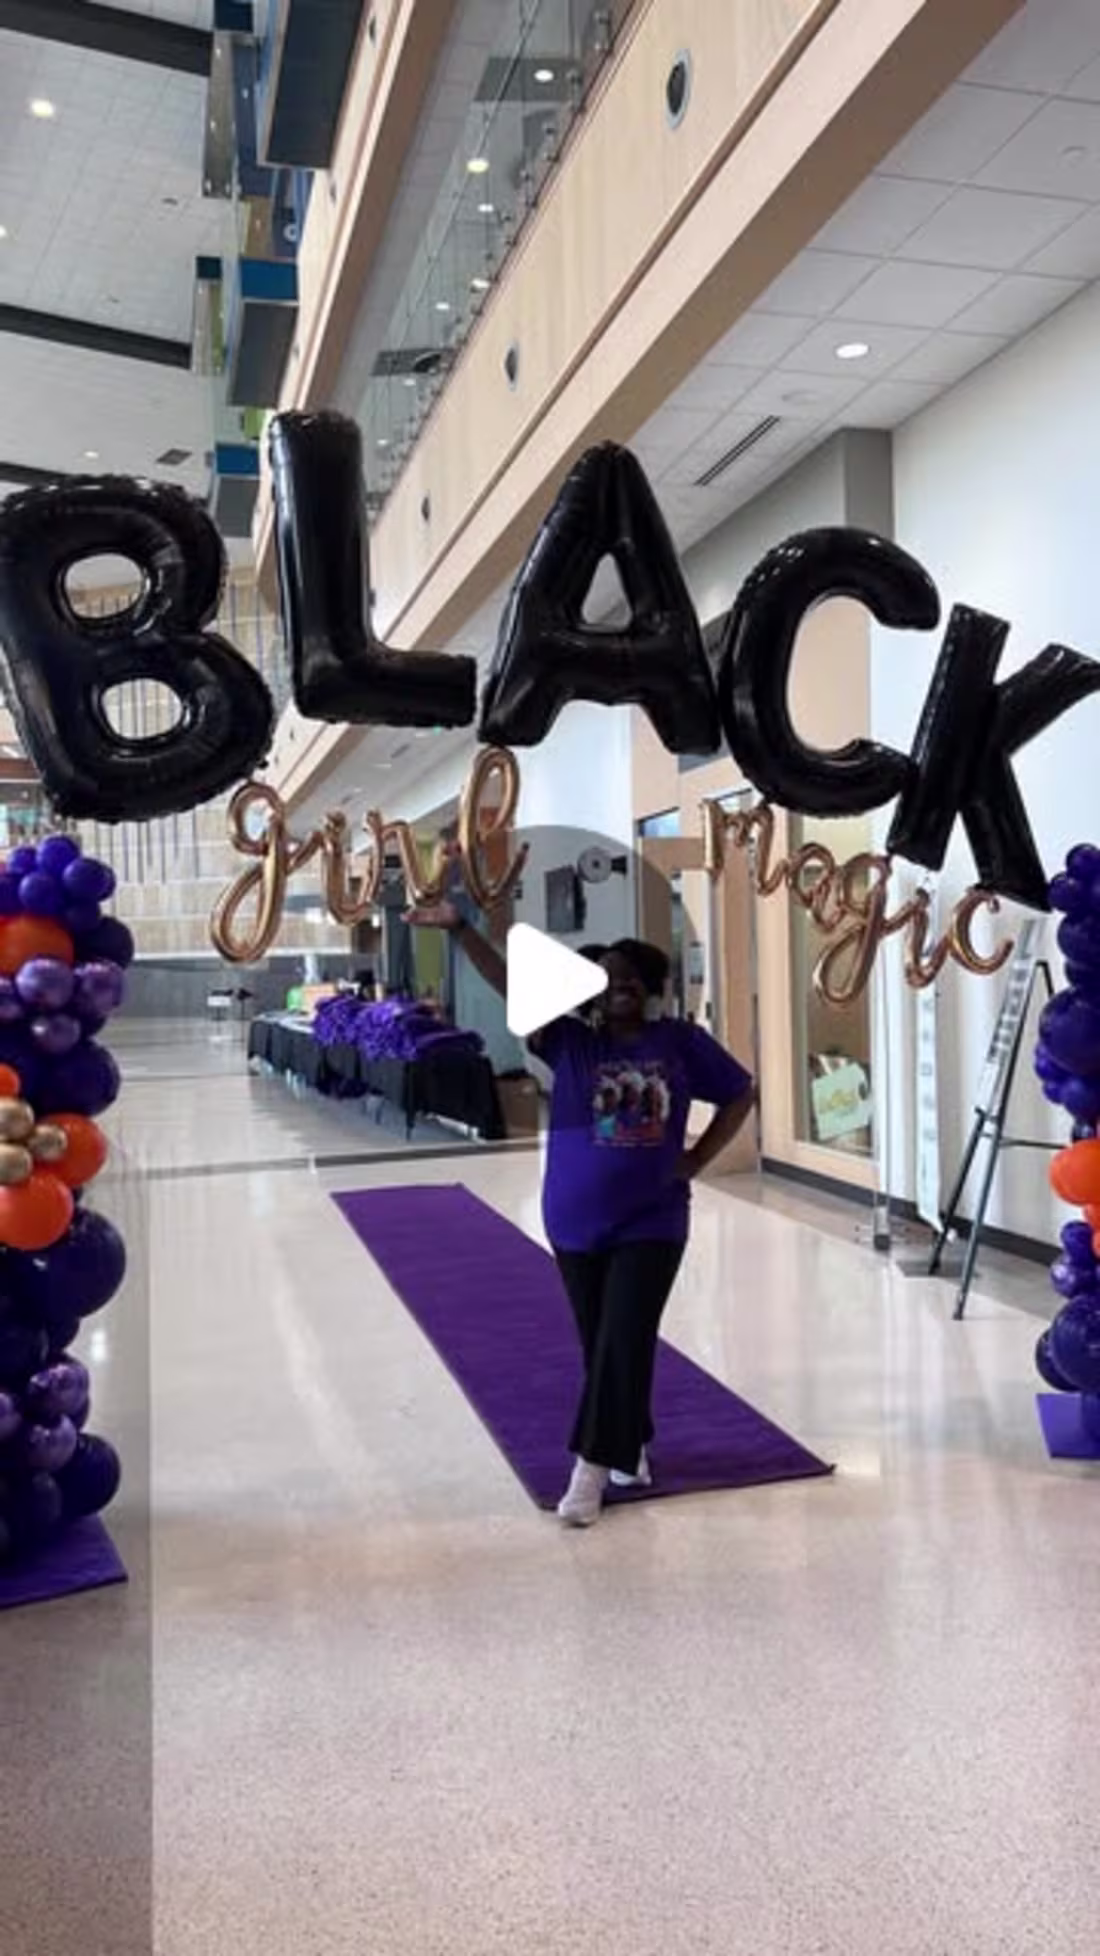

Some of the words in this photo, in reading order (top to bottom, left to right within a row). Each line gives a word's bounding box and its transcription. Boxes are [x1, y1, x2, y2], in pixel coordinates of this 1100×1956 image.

[0, 409, 1100, 912] BLACK
[210, 746, 529, 964] girl
[701, 796, 1014, 1004] magic
